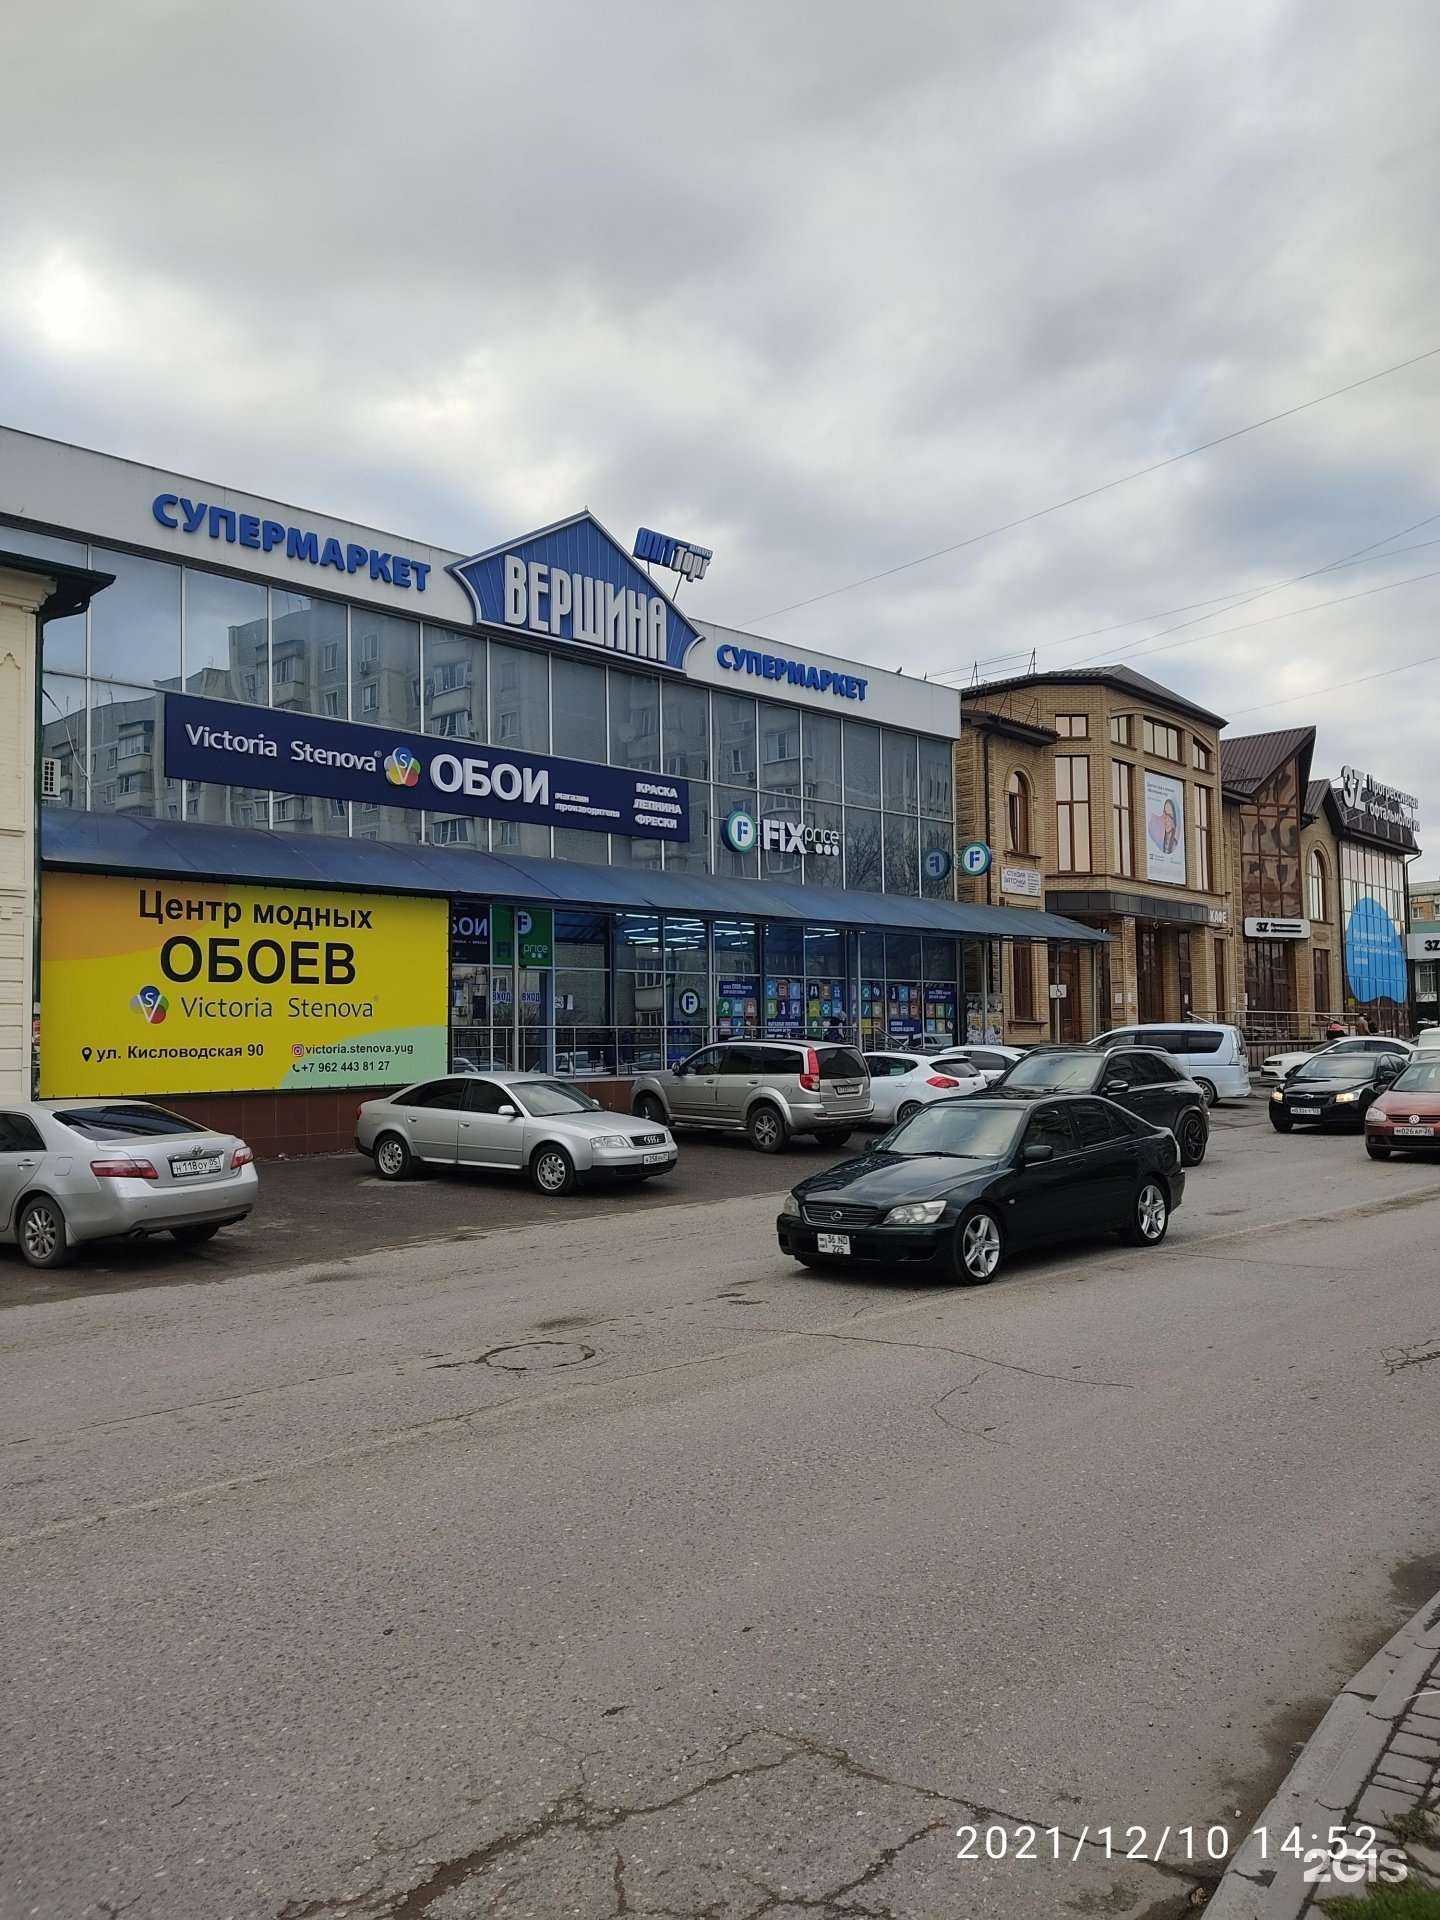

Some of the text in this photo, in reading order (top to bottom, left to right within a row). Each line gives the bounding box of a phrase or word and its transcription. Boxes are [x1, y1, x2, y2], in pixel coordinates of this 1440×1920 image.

[152, 493, 431, 591] СУПЕРМАРКЕТ
[505, 554, 667, 662] ВЕРШИНА
[717, 644, 868, 701] СУПЕРМАРКЕТ
[185, 723, 377, 772] Victoria Stenova
[429, 753, 549, 806] ОБОИ
[635, 782, 679, 799] КРАСКА
[1340, 765, 1366, 812] 3Z
[633, 798, 683, 815] ЛЕПНИНА
[634, 814, 679, 829] ФРЕСКИ
[804, 827, 840, 845] price
[139, 889, 373, 931] Центр модных
[160, 935, 356, 985] ОБОЕВ
[181, 996, 374, 1018] Victoria Stenova
[96, 1044, 264, 1062] ул. Кисловодская 90
[305, 1044, 414, 1055] victoria.stenova.yug
[301, 1060, 390, 1072] +7 962 443 81 27
